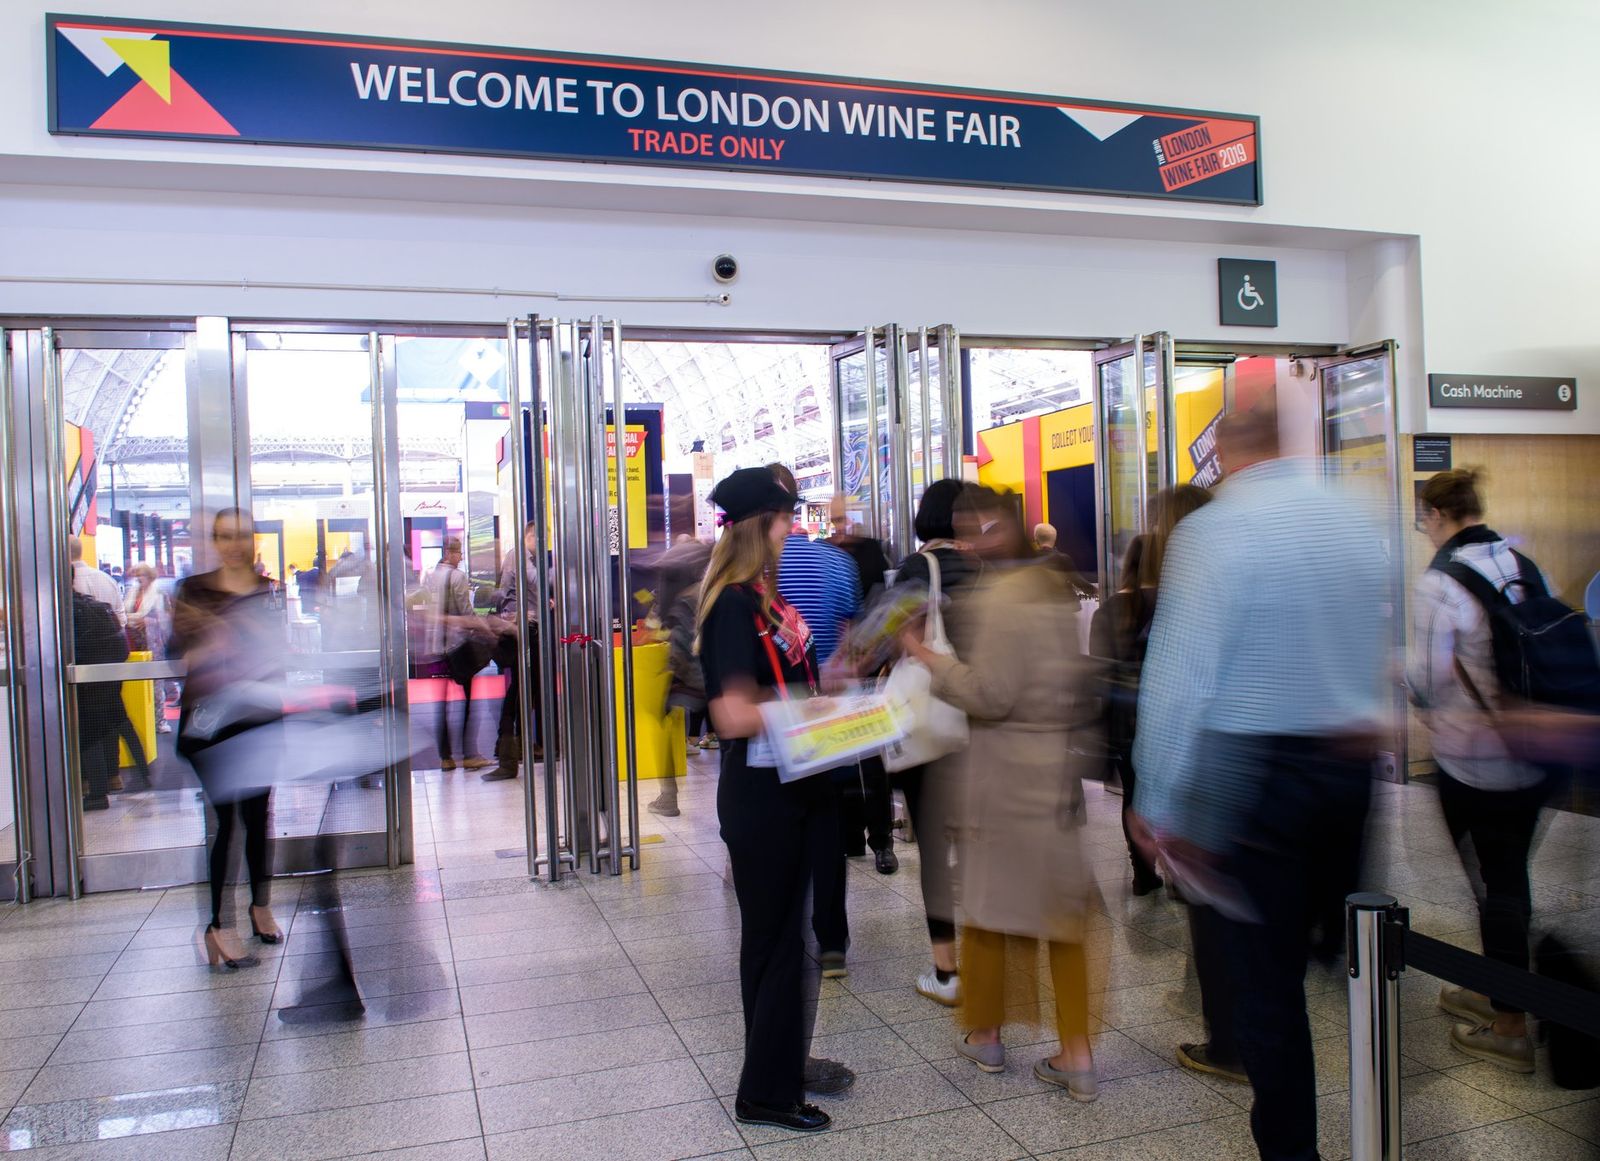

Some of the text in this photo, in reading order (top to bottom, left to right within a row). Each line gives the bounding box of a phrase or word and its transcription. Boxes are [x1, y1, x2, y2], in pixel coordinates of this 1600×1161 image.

[350, 62, 1022, 148] WELCOME TO LONDON WINE FAIR
[628, 128, 785, 161] TRADE ONLY
[1164, 126, 1212, 158] LONDON
[1163, 143, 1248, 187] WINE FAIR 2019
[1440, 383, 1471, 398] Cash
[1474, 384, 1523, 399] Machine
[607, 432, 638, 444] OCIAL
[1051, 428, 1077, 449] COLLECT
[1192, 411, 1224, 464] LOND
